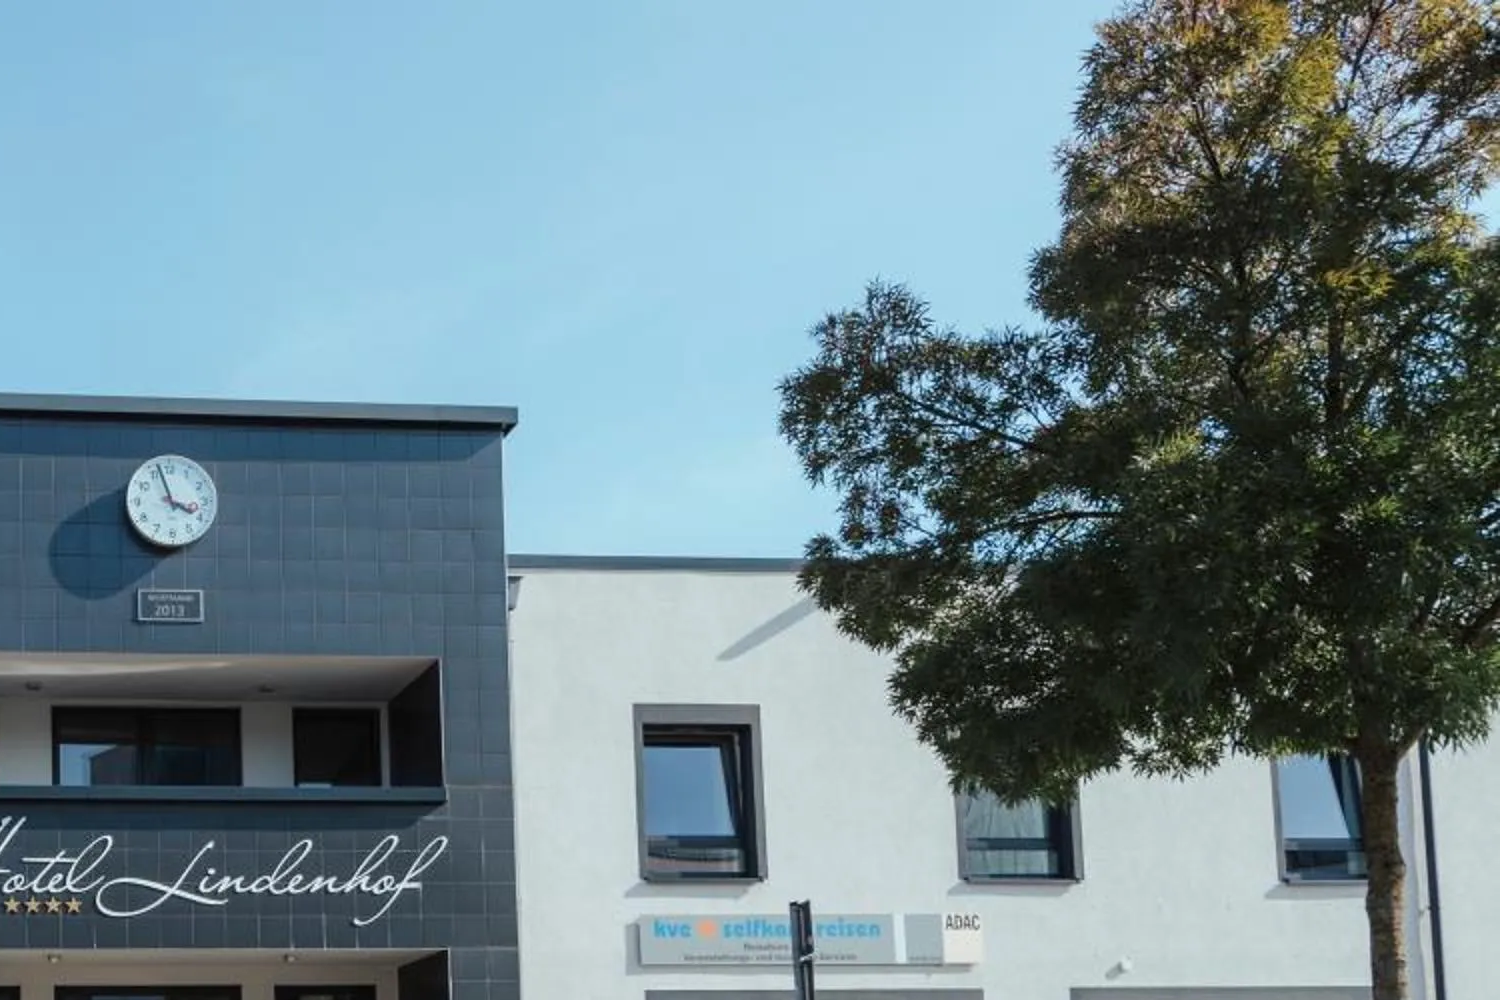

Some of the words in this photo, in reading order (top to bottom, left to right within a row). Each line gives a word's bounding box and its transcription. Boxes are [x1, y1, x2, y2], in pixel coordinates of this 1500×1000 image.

[164, 465, 174, 475] 12
[140, 481, 150, 491] 10
[169, 528, 177, 538] 6
[155, 604, 185, 617] 2013
[95, 834, 449, 926] Lindenhof
[653, 918, 693, 938] kve
[723, 919, 799, 938] selfka
[816, 918, 881, 938] reisen
[945, 914, 981, 931] ADAC
